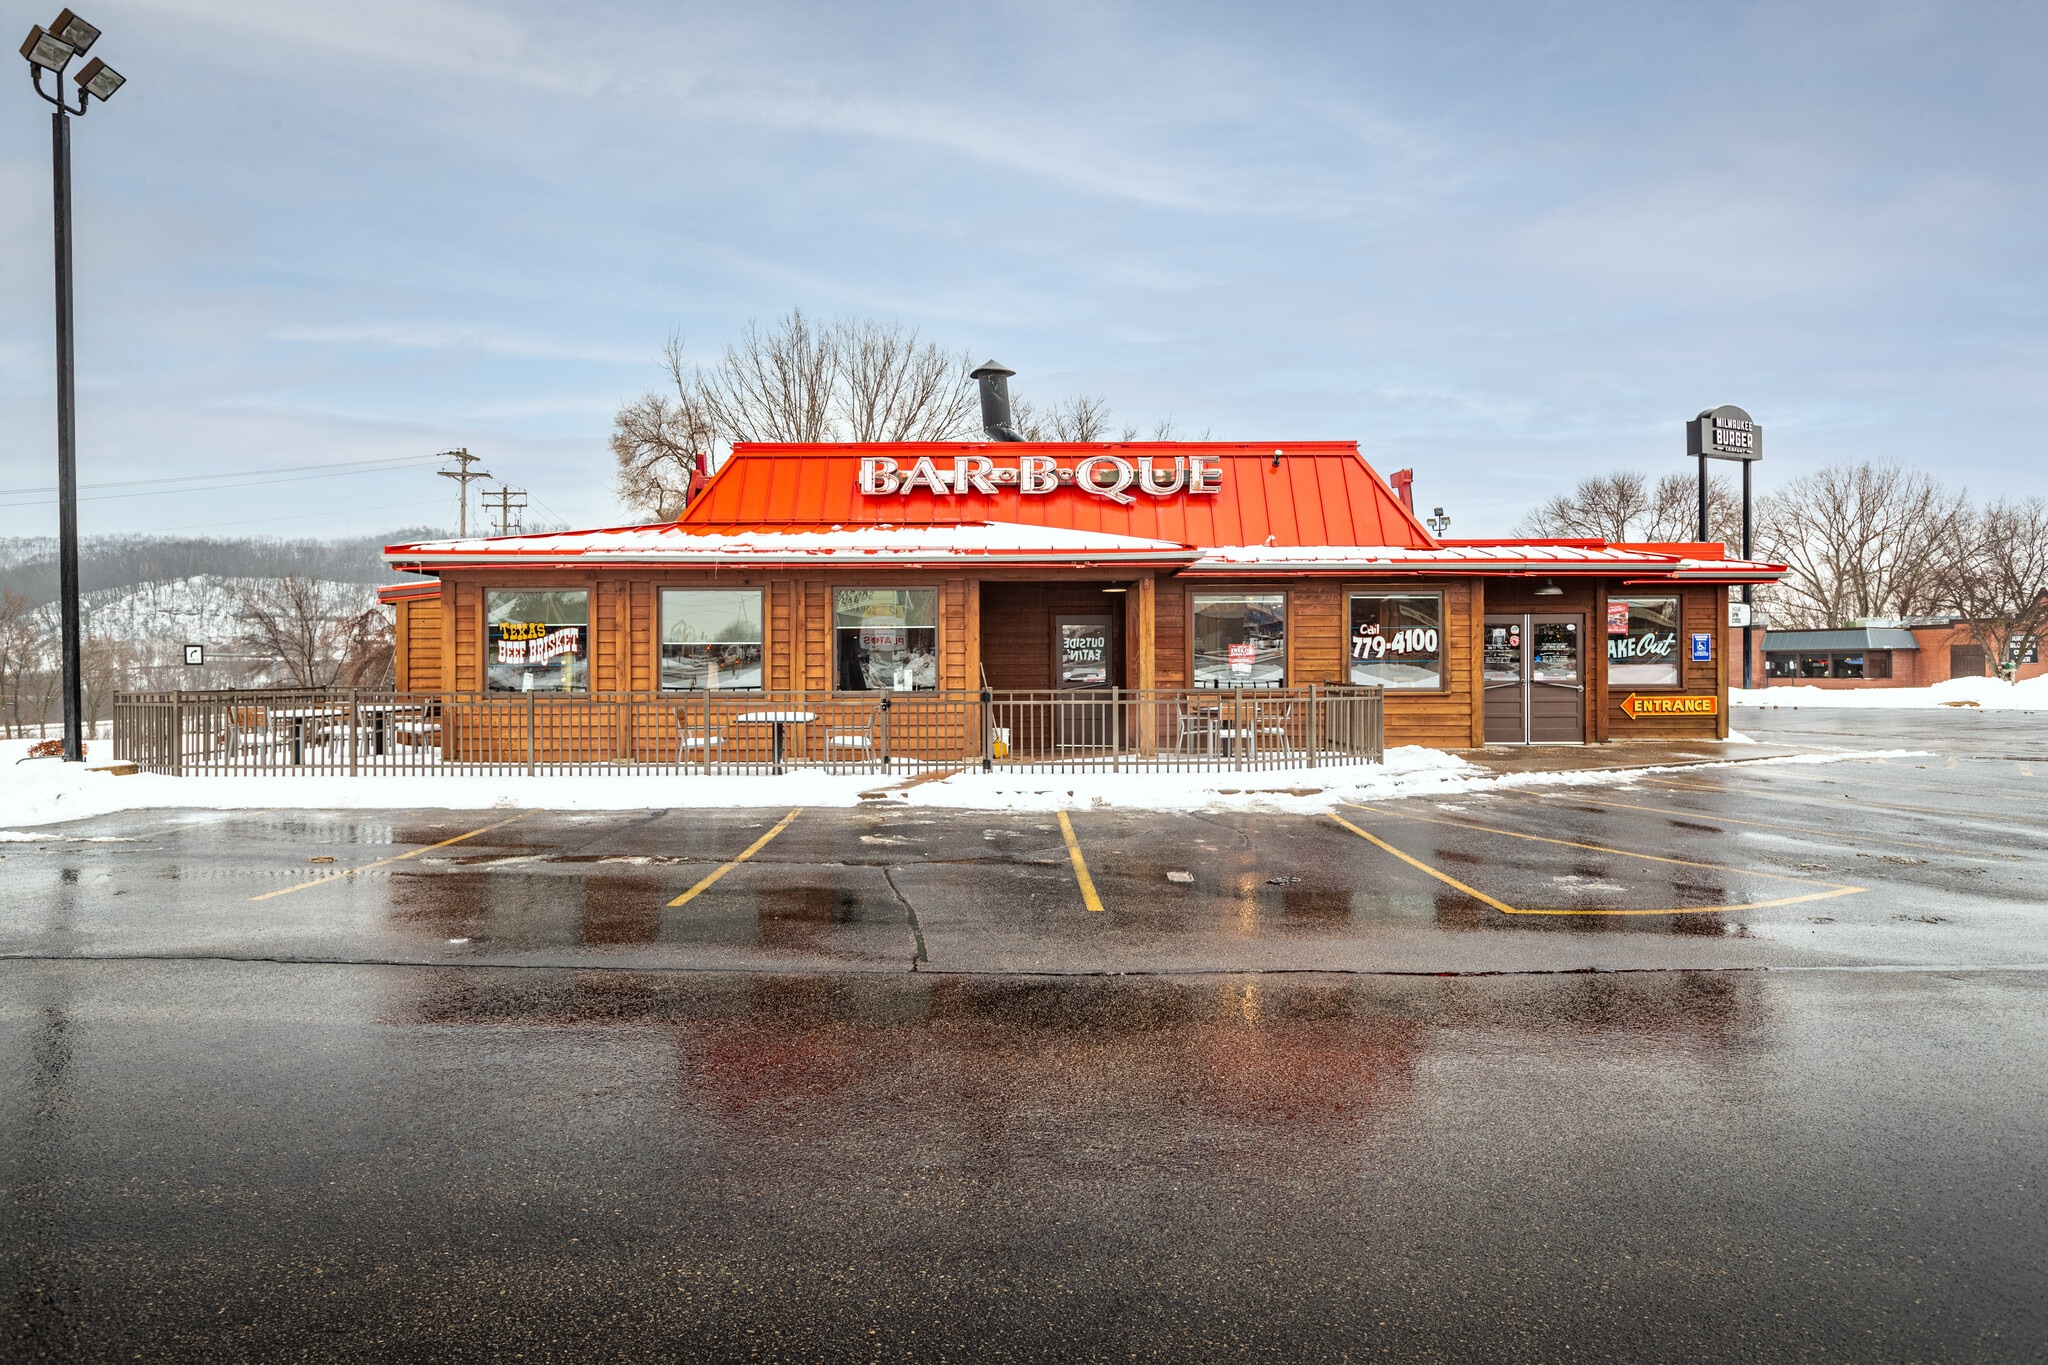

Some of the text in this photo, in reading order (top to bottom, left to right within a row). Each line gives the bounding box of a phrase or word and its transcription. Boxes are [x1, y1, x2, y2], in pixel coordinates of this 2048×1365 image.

[1716, 417, 1753, 432] MILWAUKEE
[1716, 429, 1753, 448] BURGER
[499, 621, 546, 641] TEXAS
[1359, 623, 1380, 635] Call
[497, 627, 579, 667] BEEF BRISKET
[1351, 628, 1438, 660] 779-4100
[1607, 632, 1677, 659] AKE Out
[1633, 699, 1711, 712] ENTRANCE
